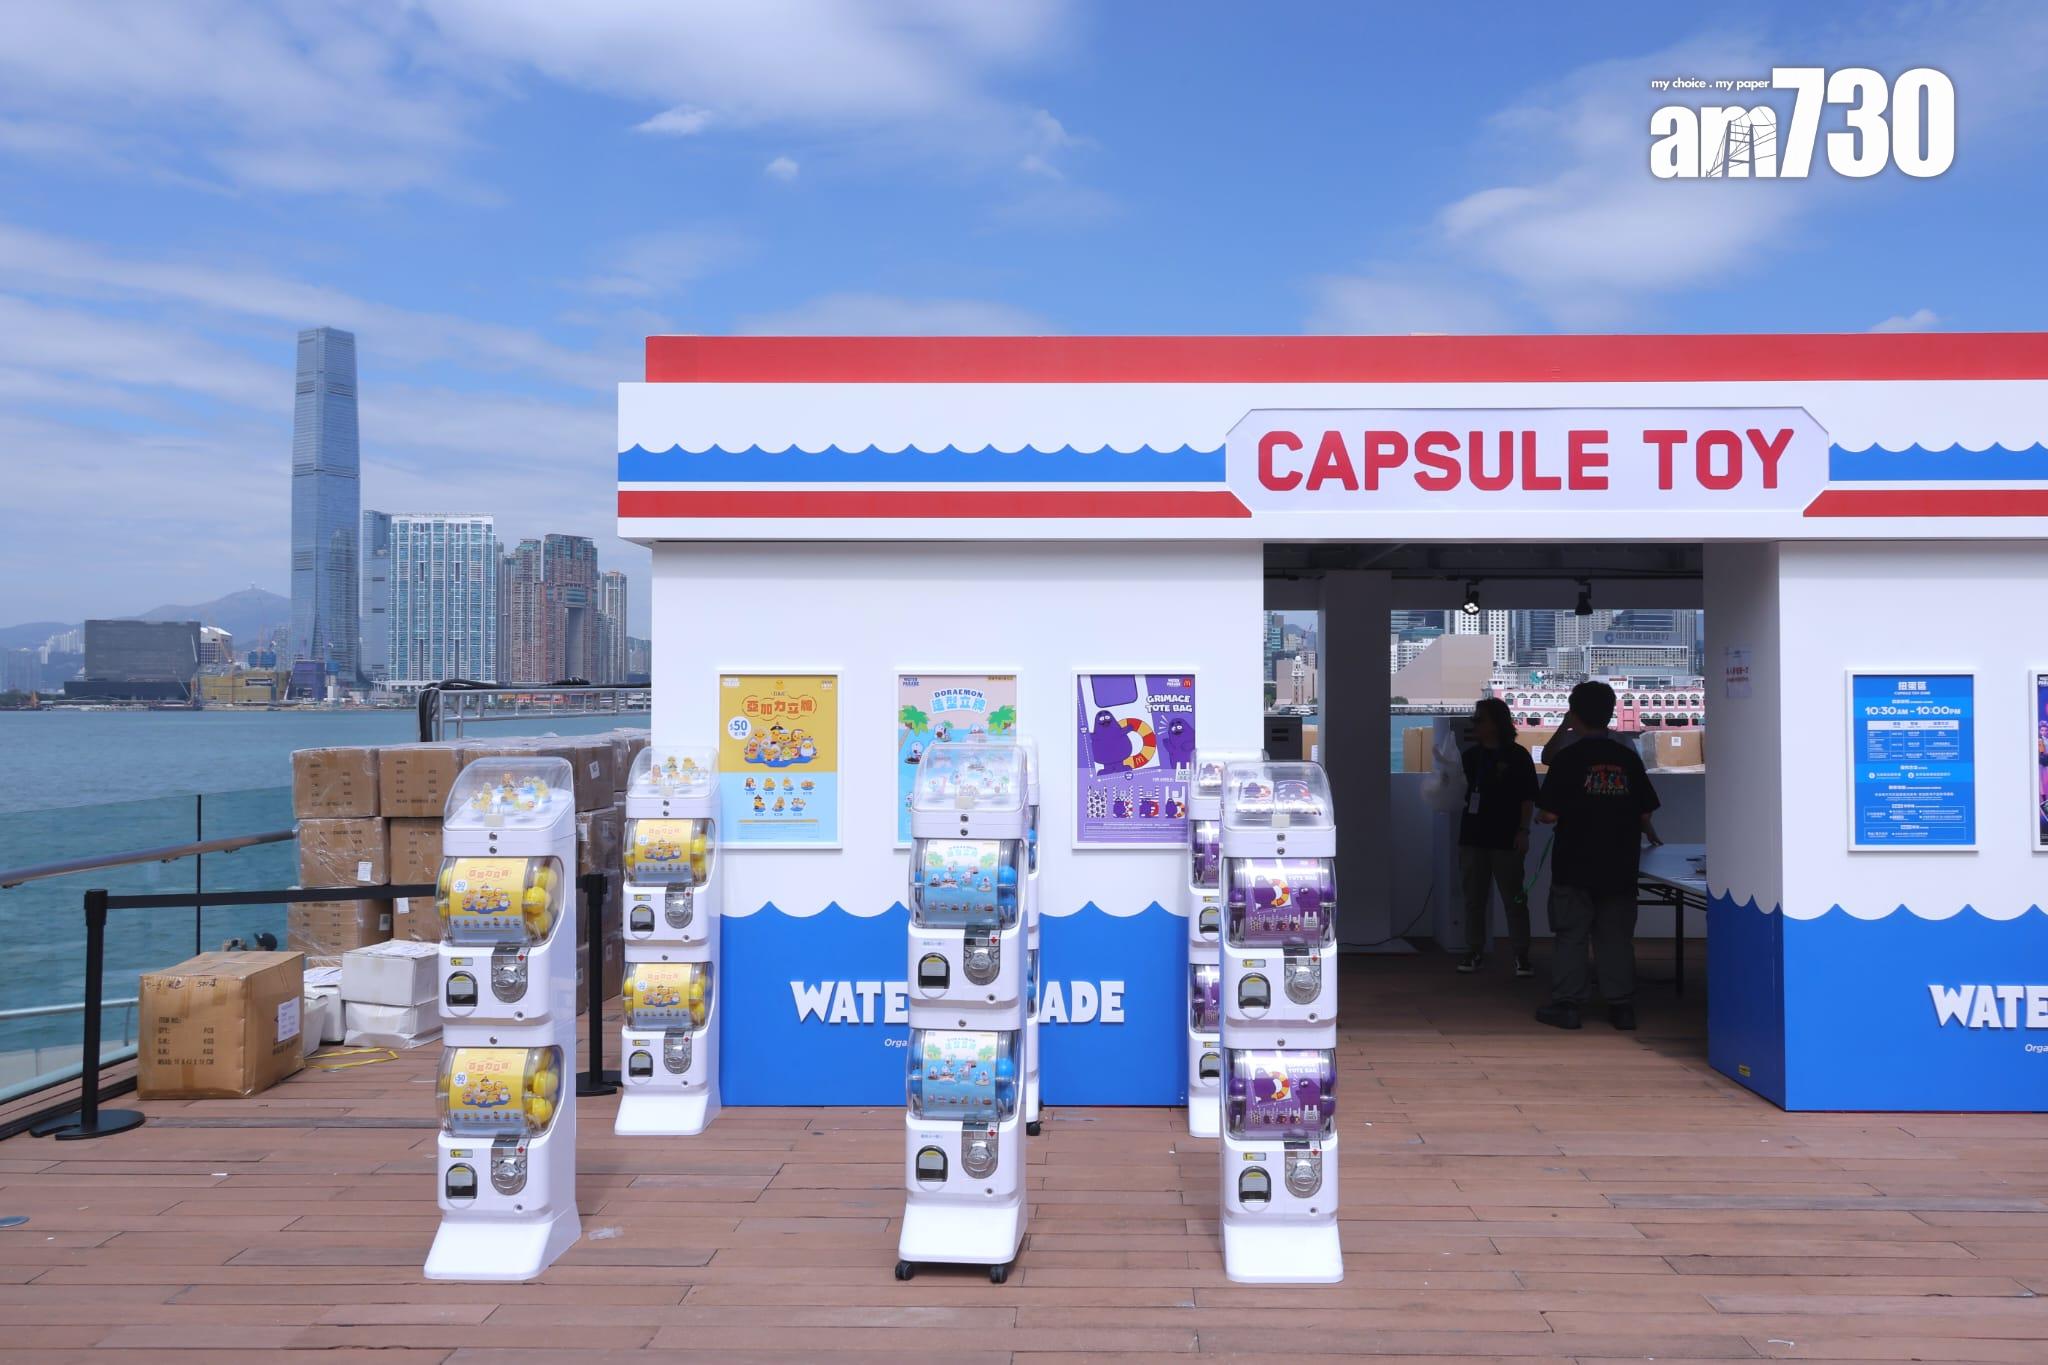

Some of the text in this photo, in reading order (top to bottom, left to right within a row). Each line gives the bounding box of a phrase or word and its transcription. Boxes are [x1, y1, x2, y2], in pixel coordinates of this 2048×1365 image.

[1257, 429, 1795, 492] CAPSULE TOY
[934, 688, 984, 699] DORAEMON
[1146, 694, 1191, 704] GRIMACE
[746, 699, 813, 715] 亞加力立牌
[1145, 704, 1193, 714] TOTE BAG
[729, 719, 748, 731] $50
